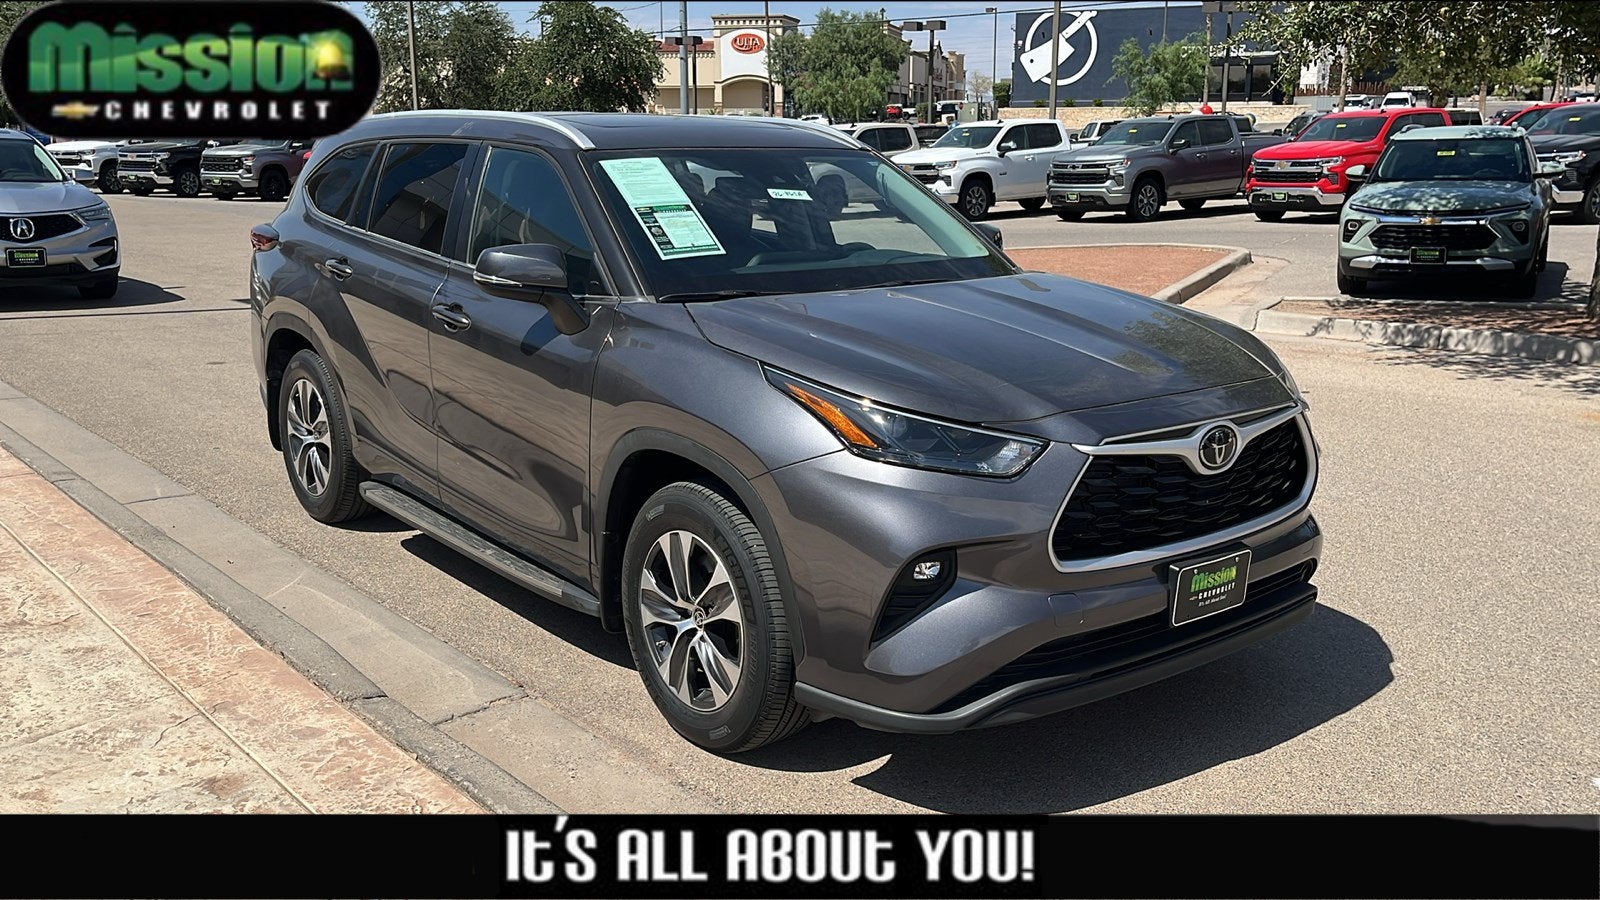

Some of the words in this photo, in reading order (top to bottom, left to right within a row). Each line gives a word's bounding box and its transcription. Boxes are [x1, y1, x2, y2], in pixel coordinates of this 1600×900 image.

[736, 37, 760, 46] ULTA
[1190, 566, 1237, 592] Mission
[1198, 582, 1235, 600] CHEVROLET
